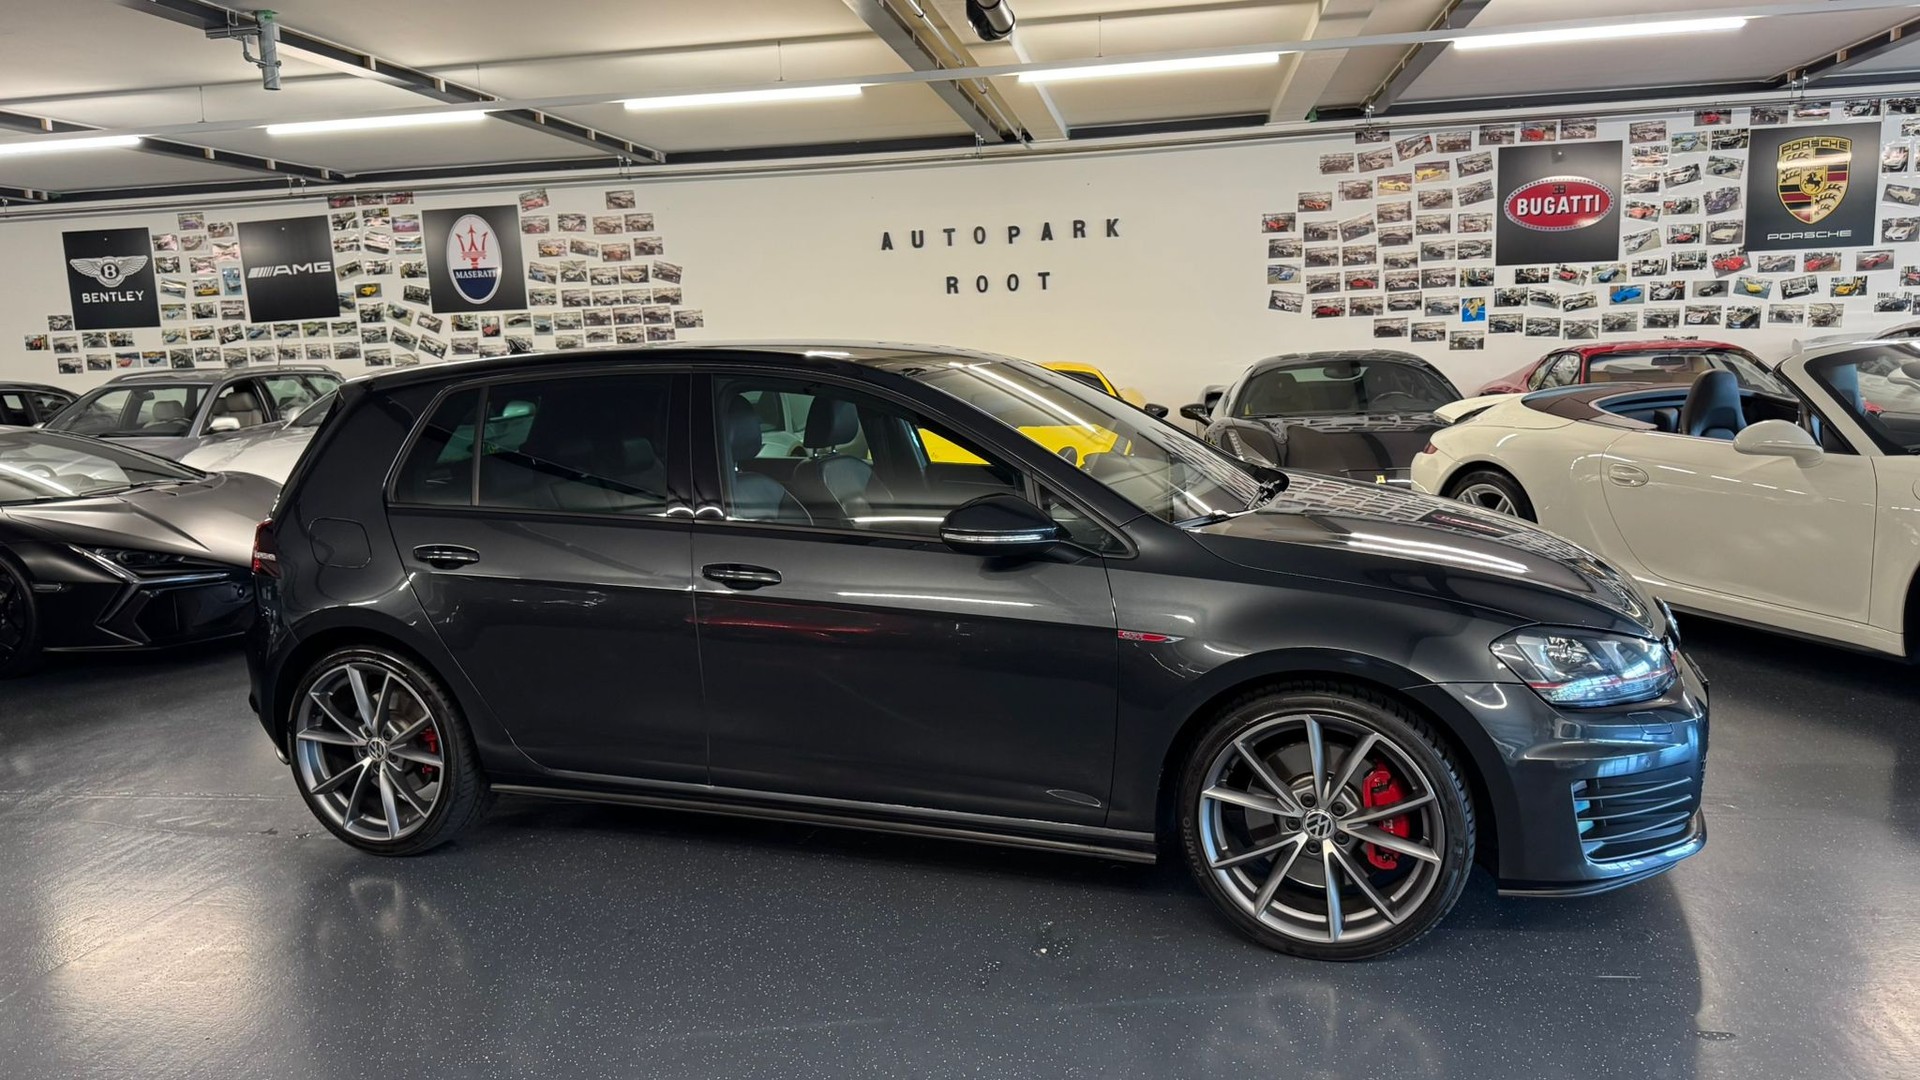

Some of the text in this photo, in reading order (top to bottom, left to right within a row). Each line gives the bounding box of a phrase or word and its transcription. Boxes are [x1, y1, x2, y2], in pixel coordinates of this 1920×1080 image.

[1781, 140, 1848, 155] PORSCHE
[1516, 195, 1601, 216] BUGATTI
[881, 218, 1119, 250] AUTOPARK
[1767, 230, 1852, 240] PORSCHE
[273, 261, 332, 277] AMG
[455, 270, 496, 279] MASERATI
[946, 272, 1050, 294] ROOT
[82, 290, 144, 304] BENTLEY
